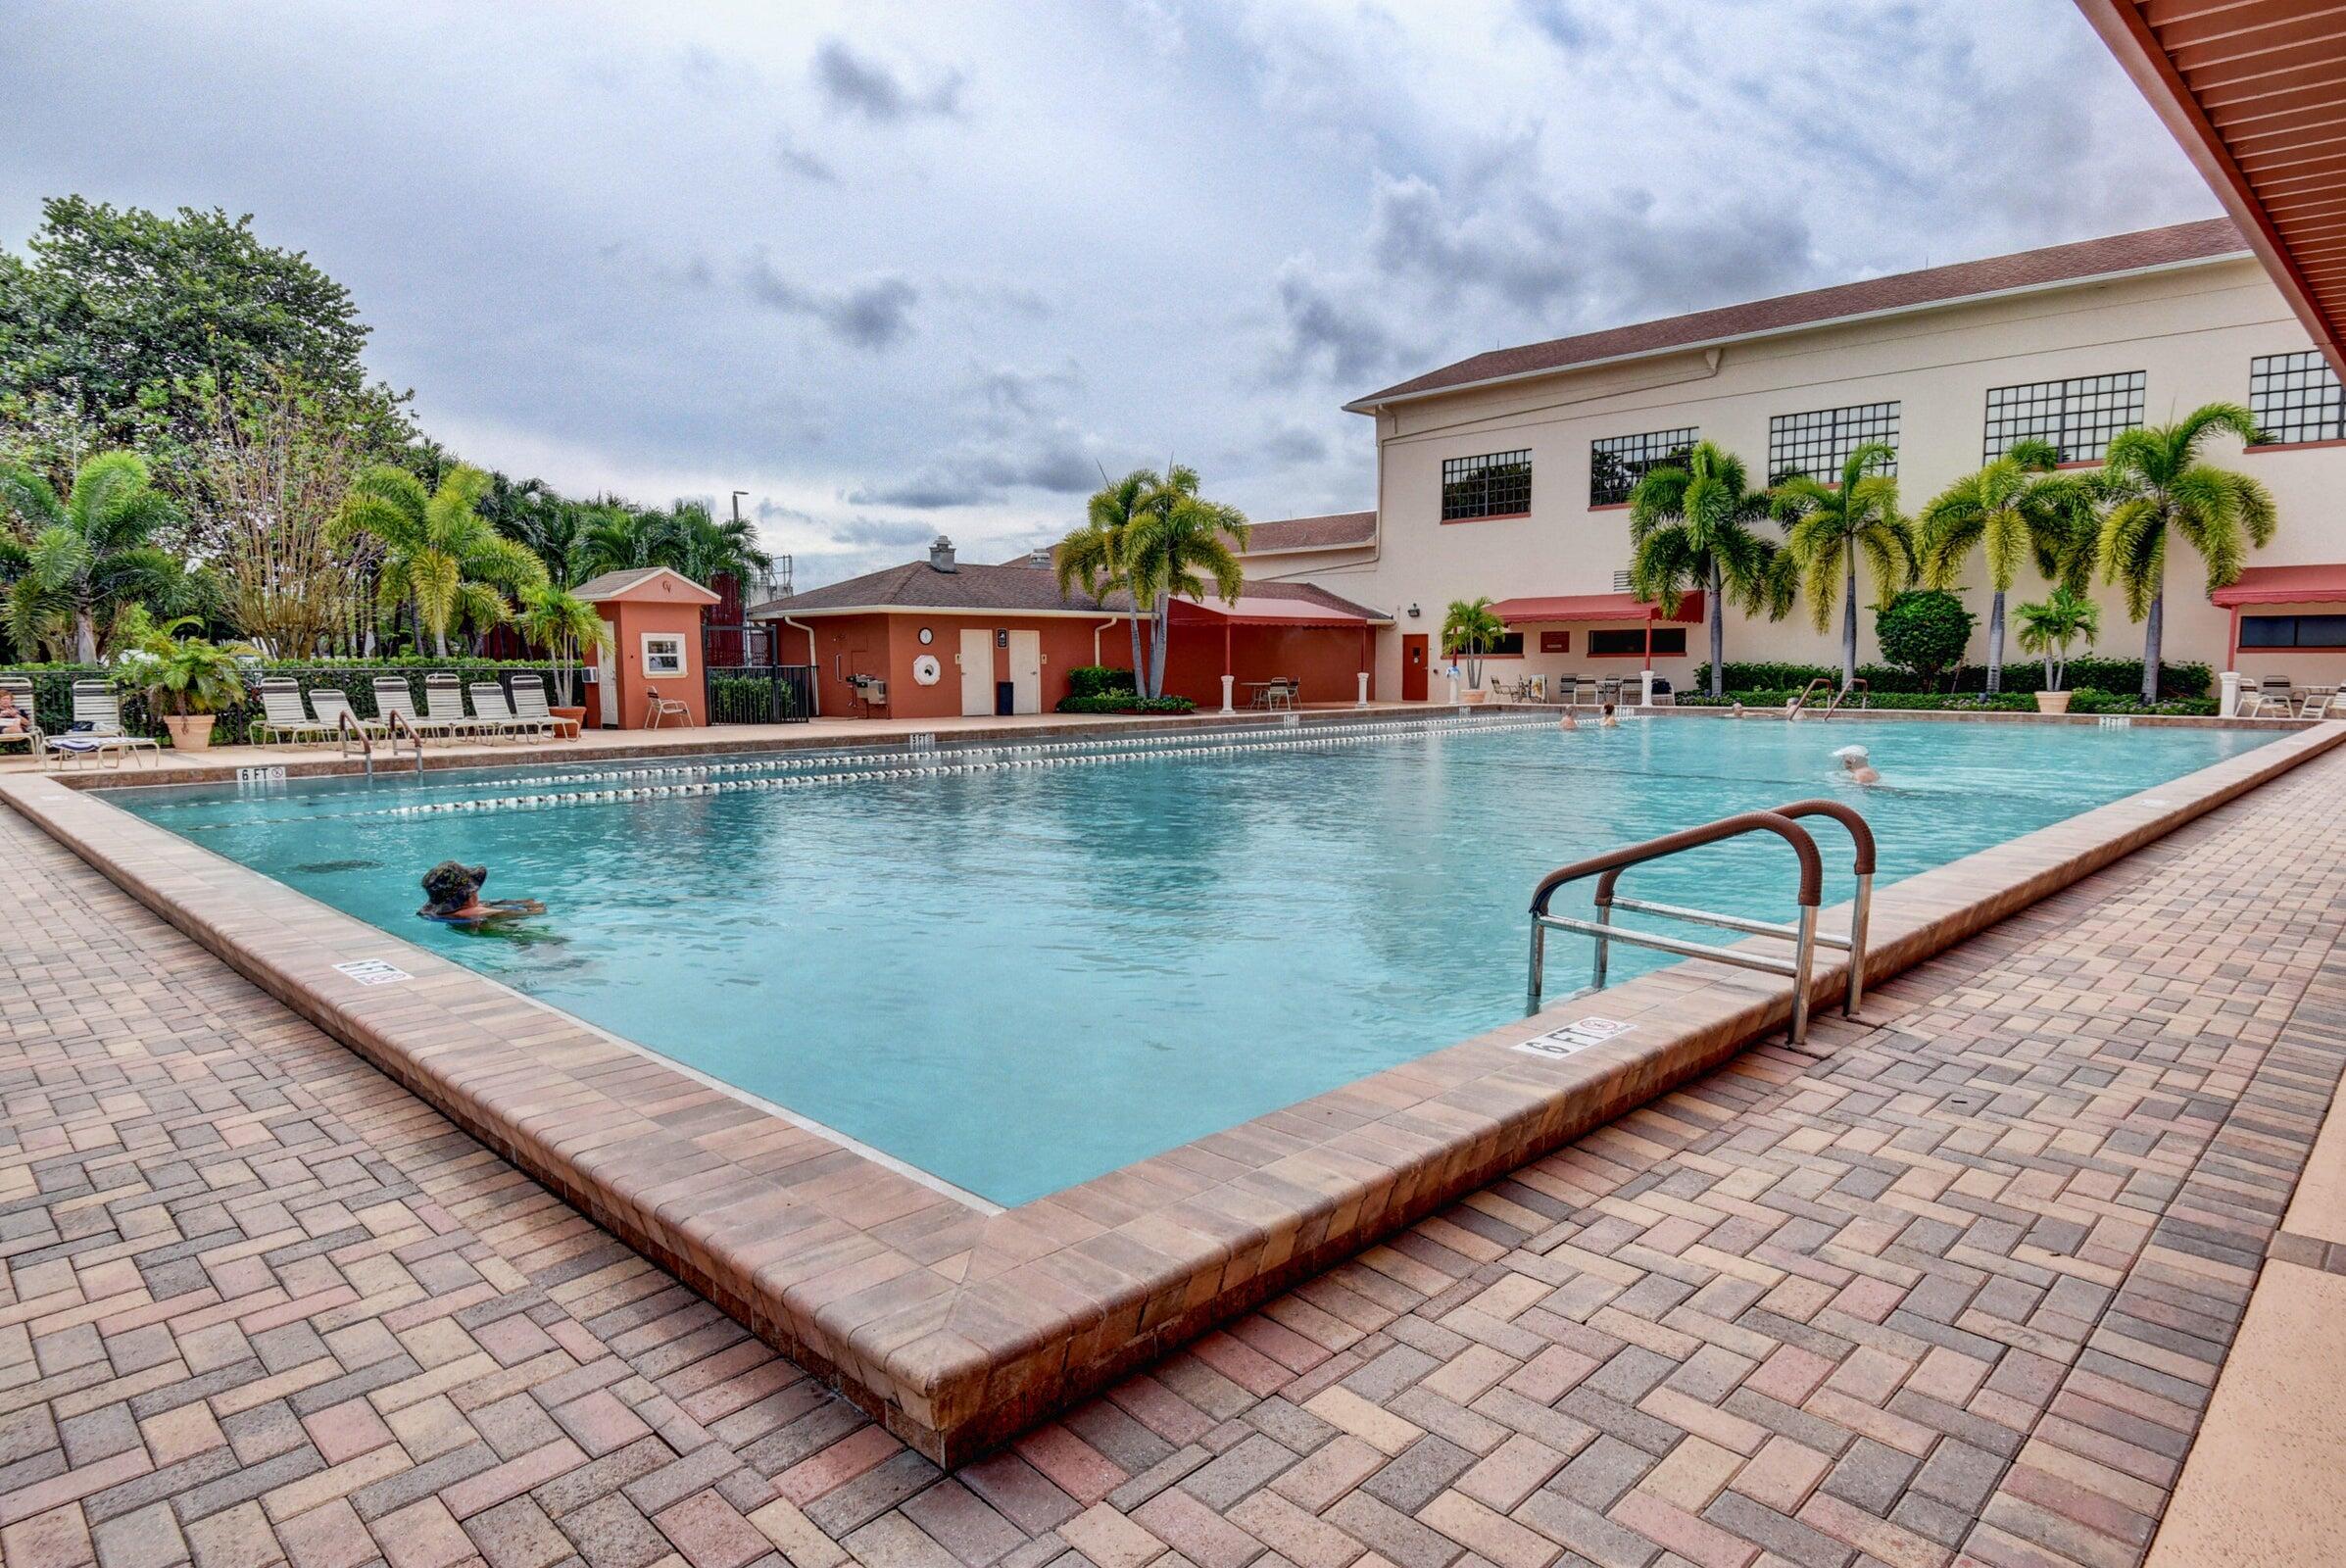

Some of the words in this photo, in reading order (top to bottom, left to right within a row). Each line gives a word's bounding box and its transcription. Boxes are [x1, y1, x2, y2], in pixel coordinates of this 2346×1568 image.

[241, 768, 249, 780] 6
[254, 767, 269, 780] FT
[1546, 1027, 1605, 1046] FT
[1525, 1042, 1571, 1054] 6
